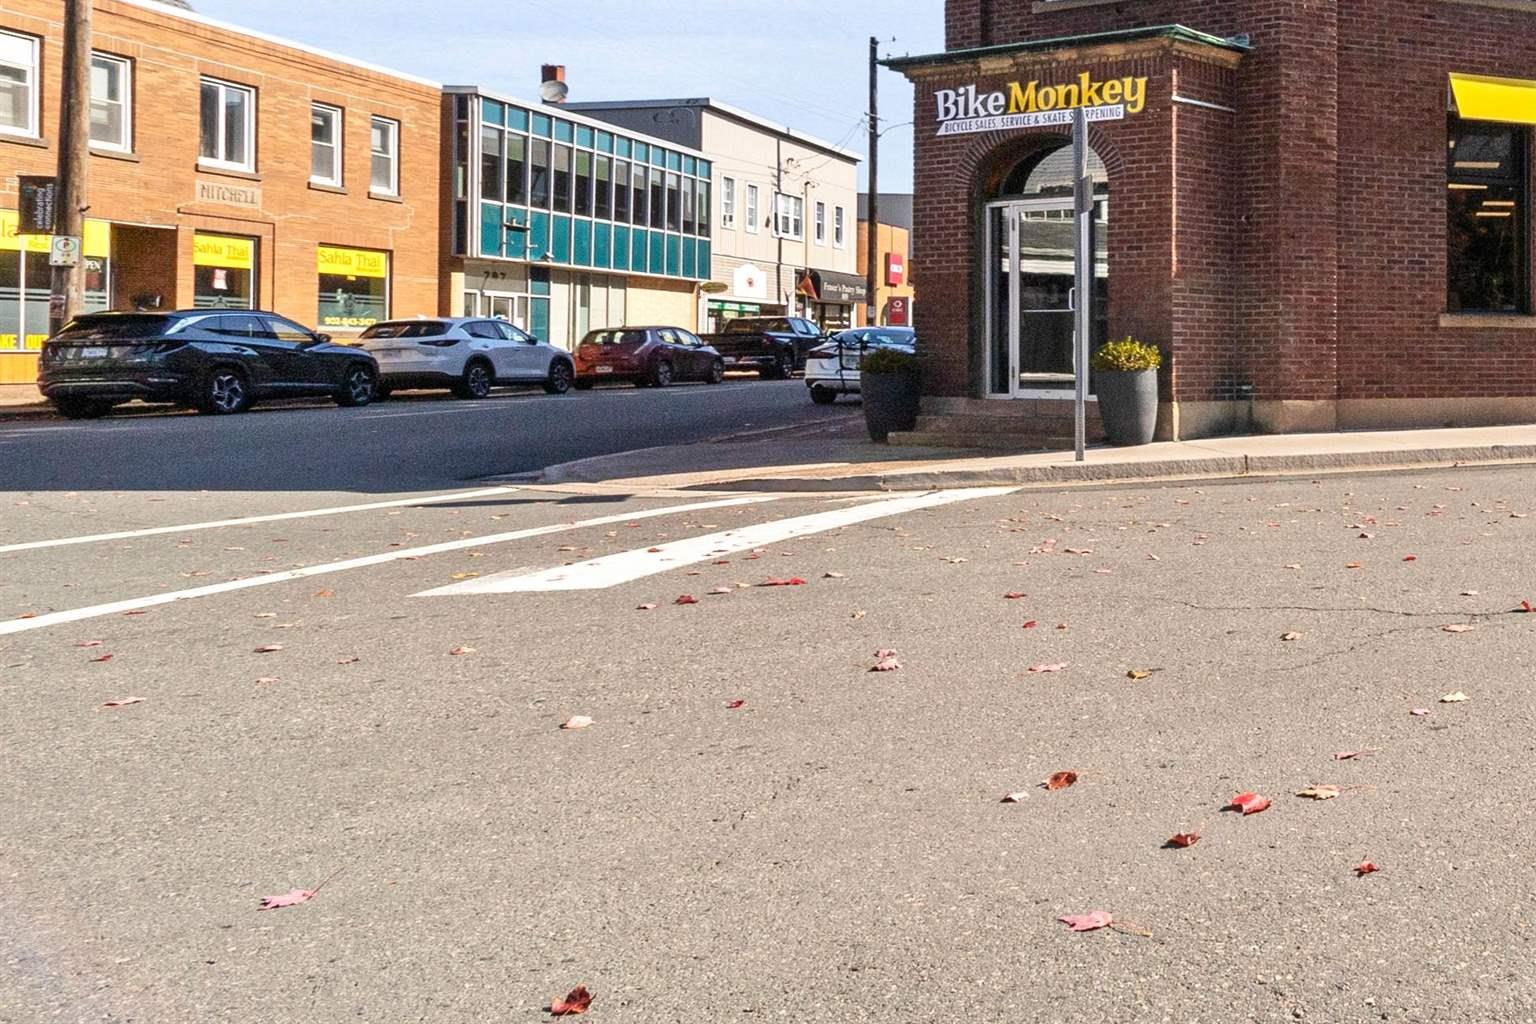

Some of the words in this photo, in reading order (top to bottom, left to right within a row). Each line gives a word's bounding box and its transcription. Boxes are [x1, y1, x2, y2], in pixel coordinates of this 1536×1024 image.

[933, 84, 1005, 122] Bike
[1007, 71, 1149, 113] Monkey
[944, 120, 973, 133] BICYCLE
[1000, 114, 1032, 127] SERVICE
[1033, 114, 1040, 125] &
[1042, 111, 1066, 124] SKATE
[1068, 106, 1121, 122] SRPENING
[200, 183, 257, 205] MITCHELL
[319, 249, 353, 266] Sahla
